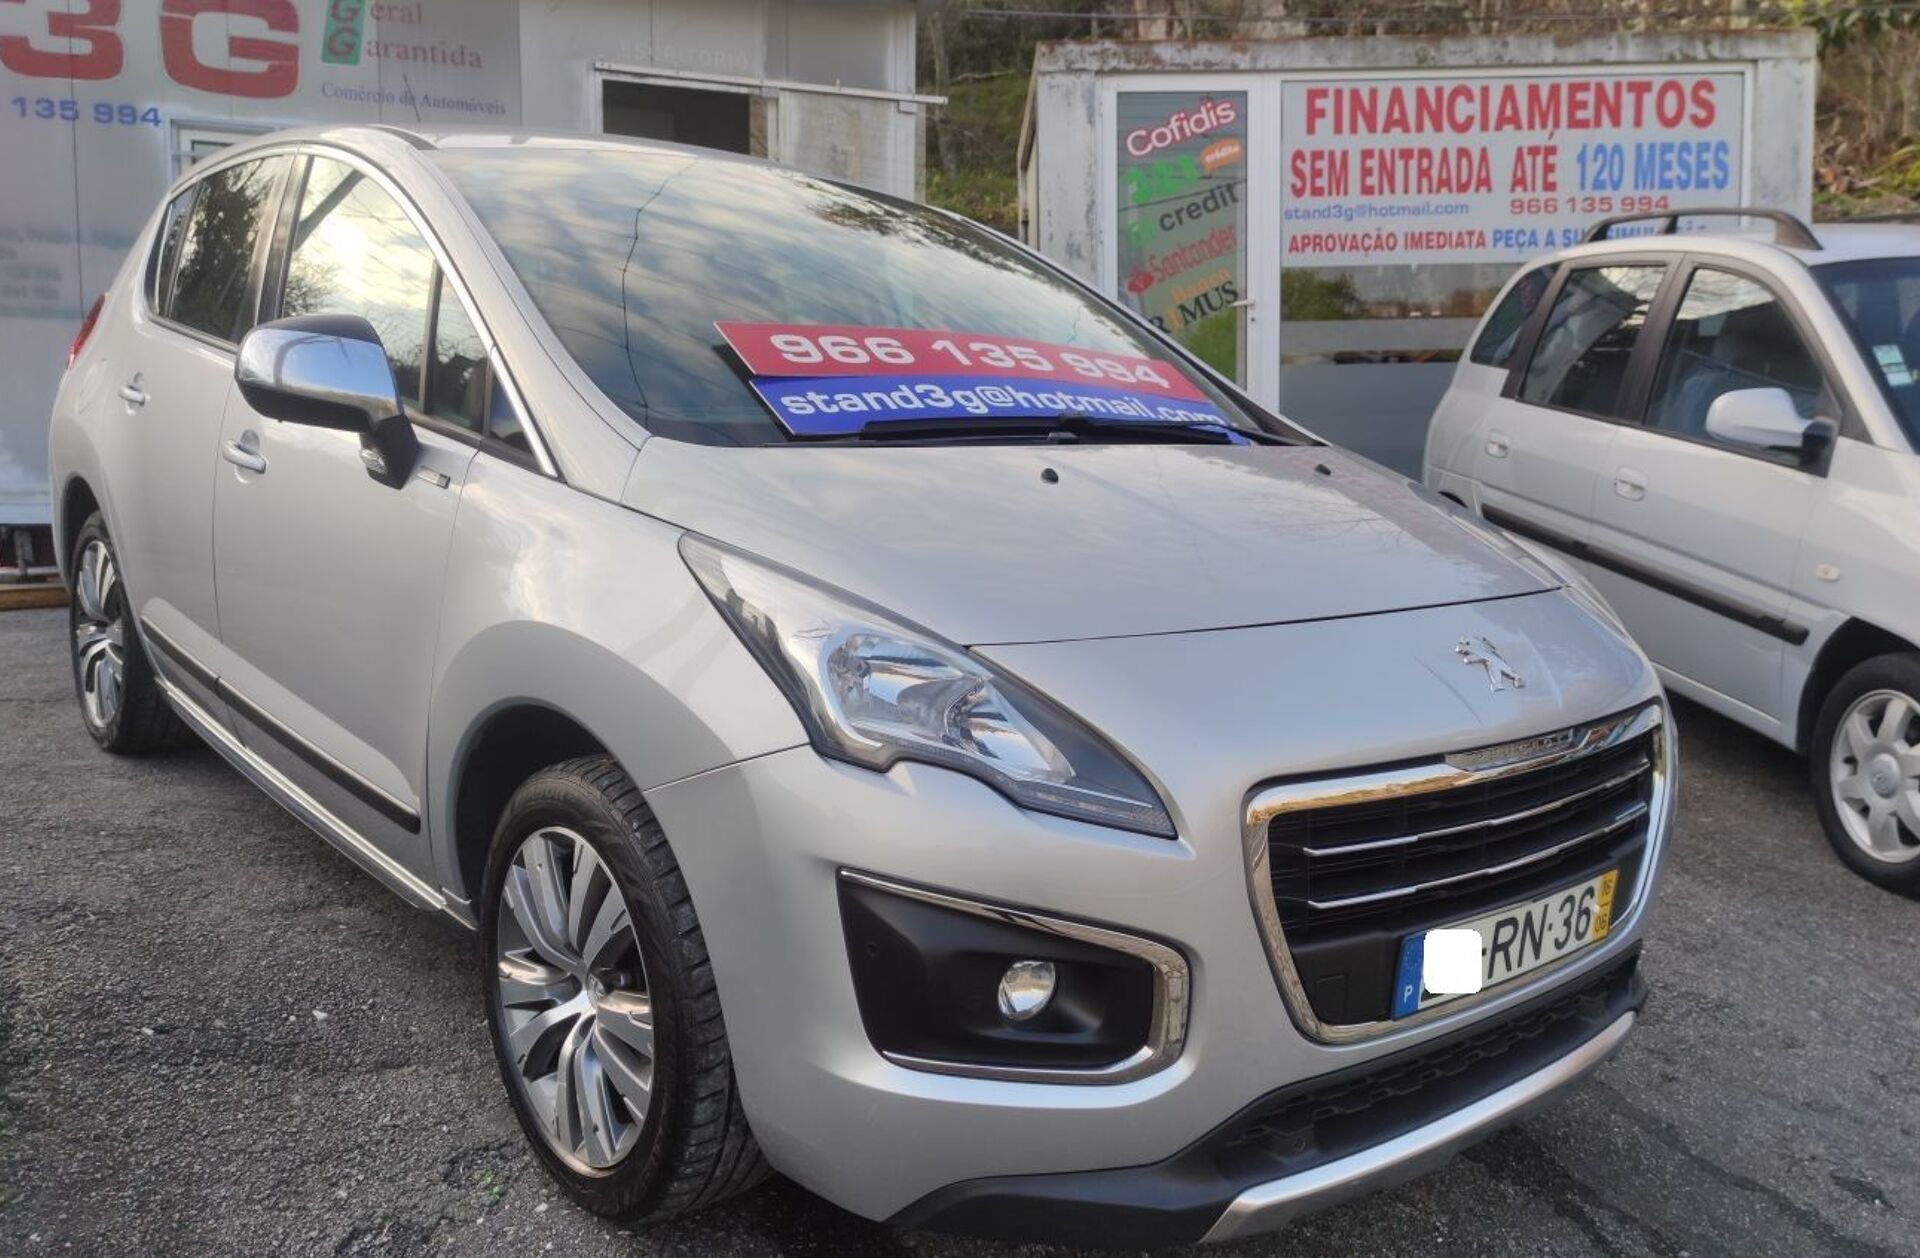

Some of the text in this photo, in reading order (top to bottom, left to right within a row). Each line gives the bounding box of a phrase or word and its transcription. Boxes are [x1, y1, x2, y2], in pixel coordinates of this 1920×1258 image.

[12, 97, 161, 126] 135 994
[321, 82, 395, 105] Comércio
[419, 93, 507, 116] Automóveis
[1306, 78, 1716, 135] FINANCIAMENTOS
[1126, 100, 1236, 156] Cofidis
[1290, 130, 1729, 198] SEM ENTRADA ATÉ 120 MESES
[1159, 183, 1239, 231] credit
[1284, 202, 1469, 221] stand3g@hotmail.com
[1510, 195, 1669, 214] 966 135 994
[1288, 227, 1398, 256] APROVAÇÃO
[1404, 231, 1486, 250] IMEDIATA
[1492, 228, 1537, 252] PEÇA
[1544, 229, 1556, 247] A
[770, 334, 1171, 389] 966 135 994
[781, 384, 1227, 424] stand3g@hotmail.com
[1404, 984, 1413, 1002] P
